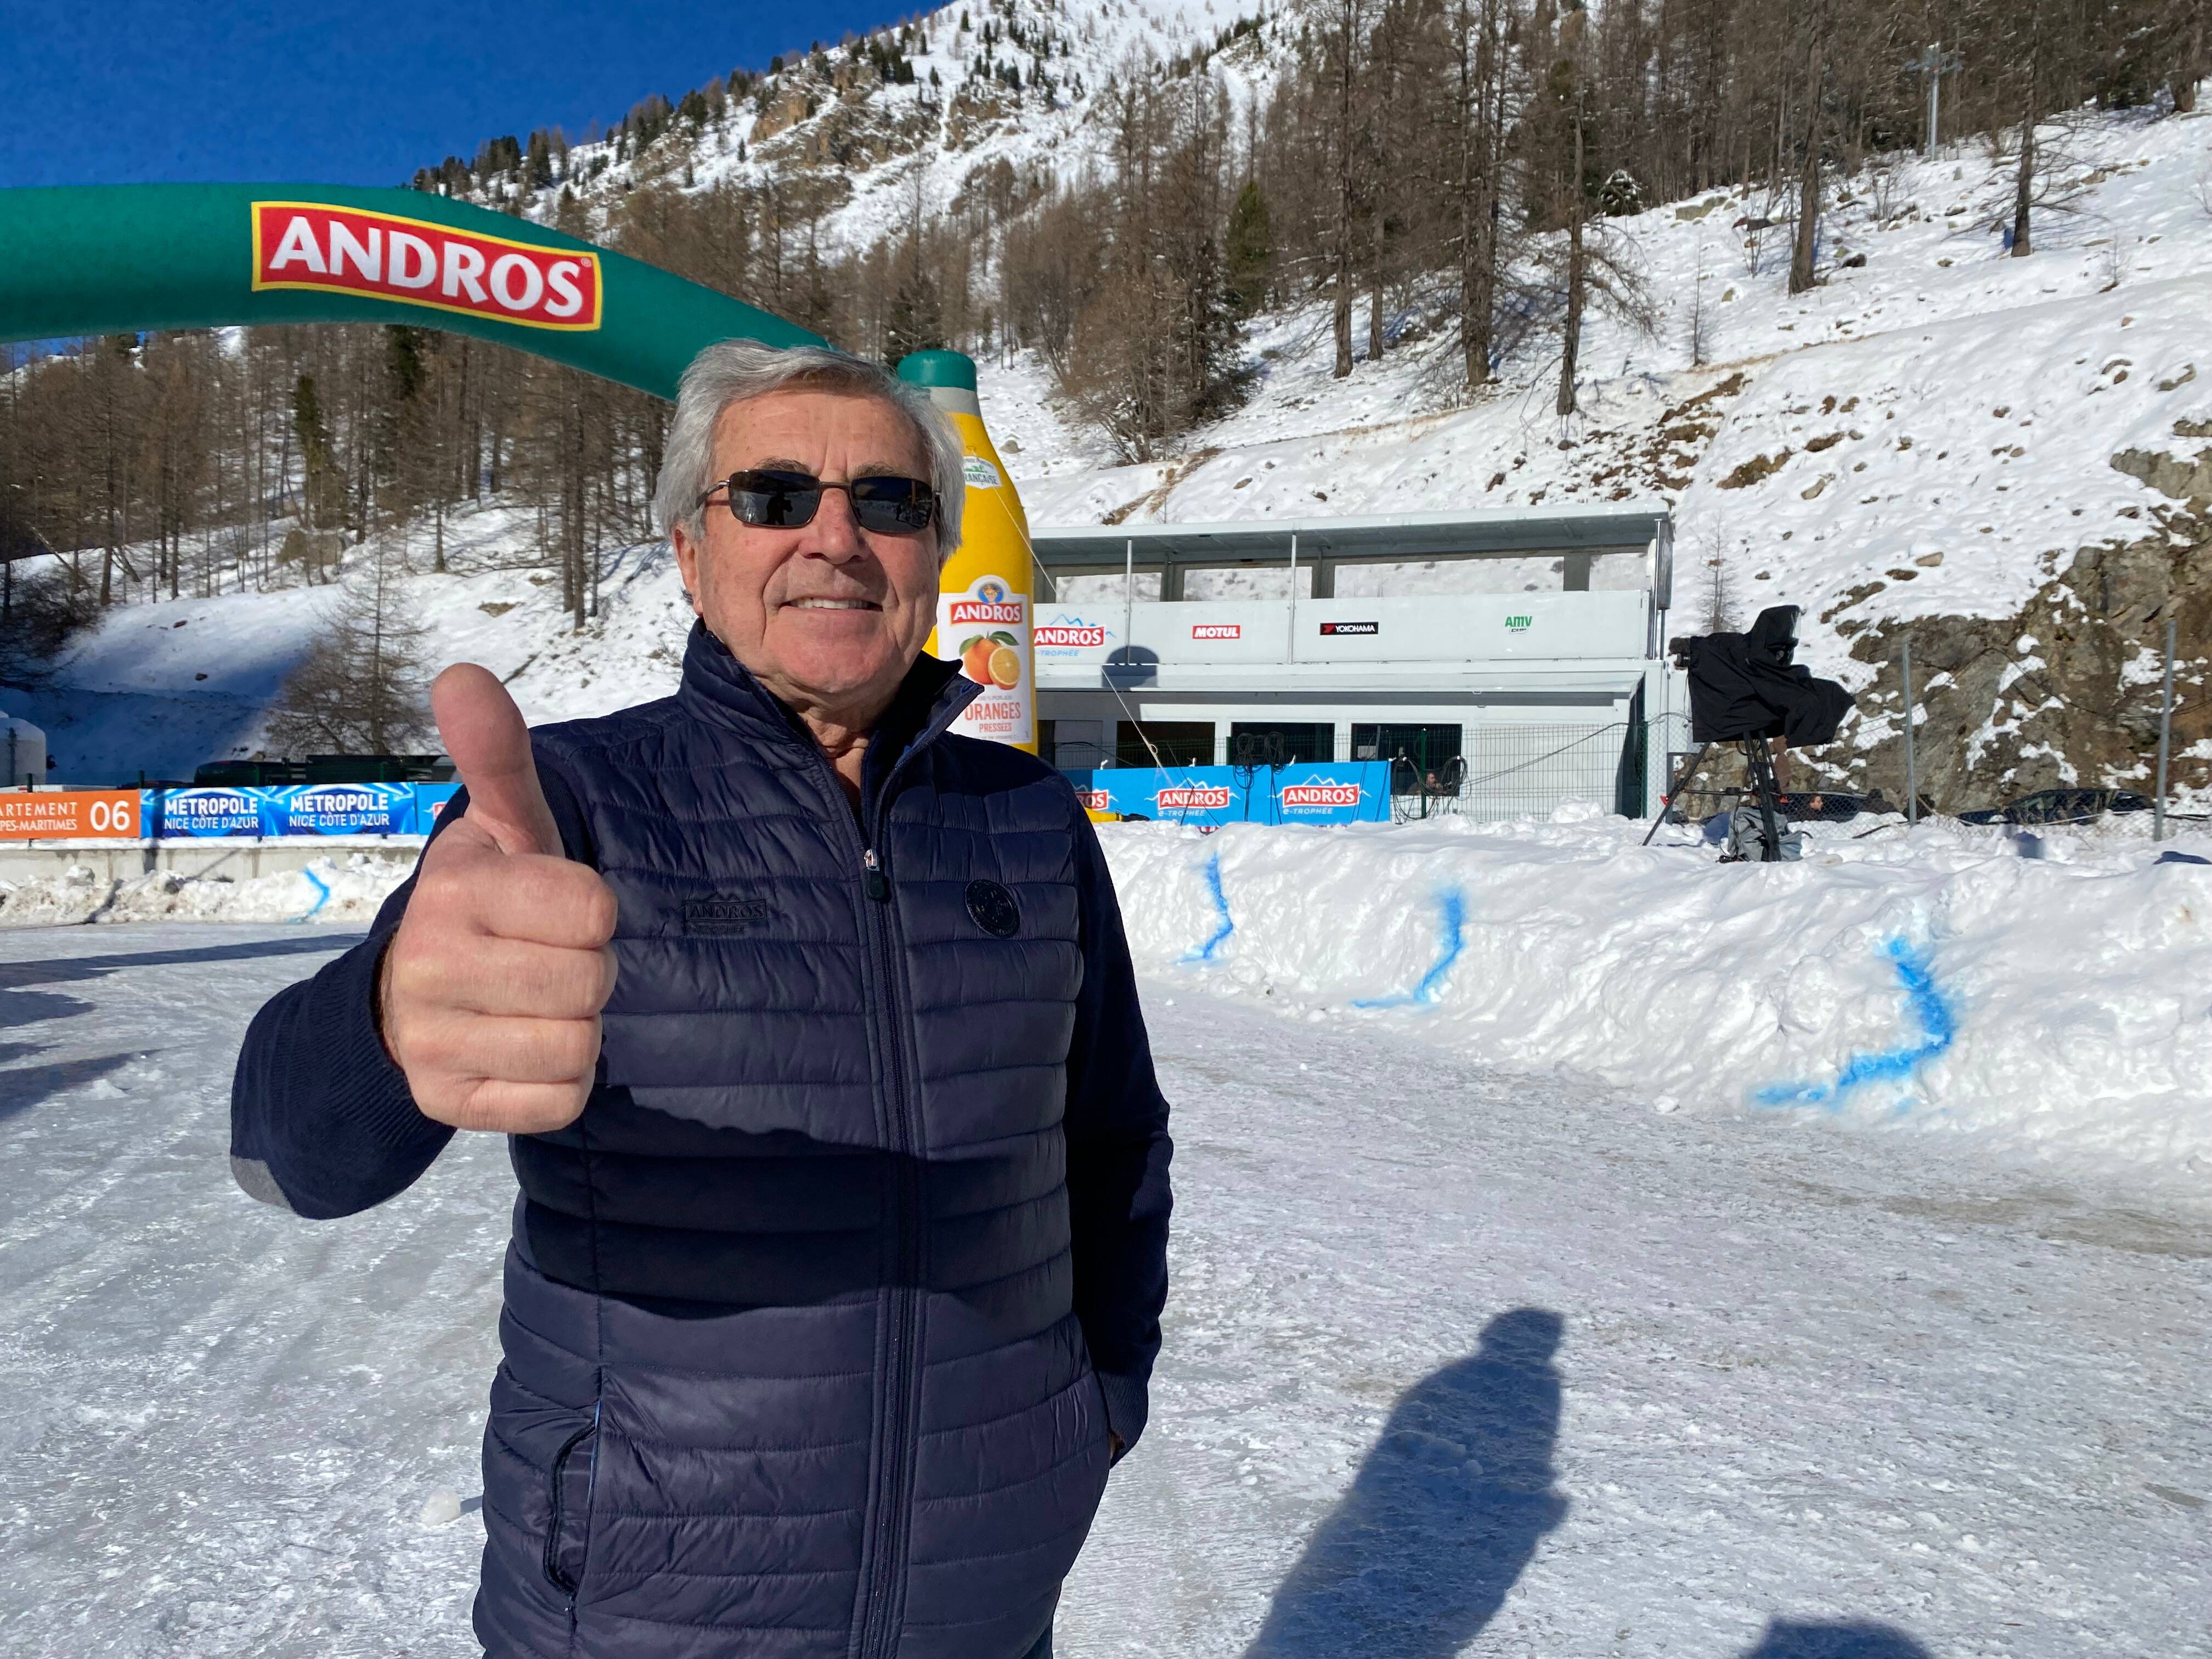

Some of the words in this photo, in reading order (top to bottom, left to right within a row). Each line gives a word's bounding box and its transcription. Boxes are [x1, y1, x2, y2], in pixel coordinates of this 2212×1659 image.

[269, 216, 583, 317] ANDROS
[953, 605, 1020, 622] ANDROS
[1034, 629, 1101, 645] ANDROS
[1194, 627, 1238, 637] MOTUL
[965, 702, 1021, 720] ORANGES
[1161, 791, 1225, 805] ANDROS
[1286, 788, 1355, 803] ANDROS
[90, 800, 131, 831] 06
[165, 817, 189, 830] NICE
[192, 815, 219, 829] CÔTE
[222, 816, 259, 828] D'AZUR
[289, 815, 316, 827] NICE
[319, 811, 347, 826] CÔTE
[350, 813, 390, 826] D'AZUR
[690, 905, 764, 918] ANDROS
